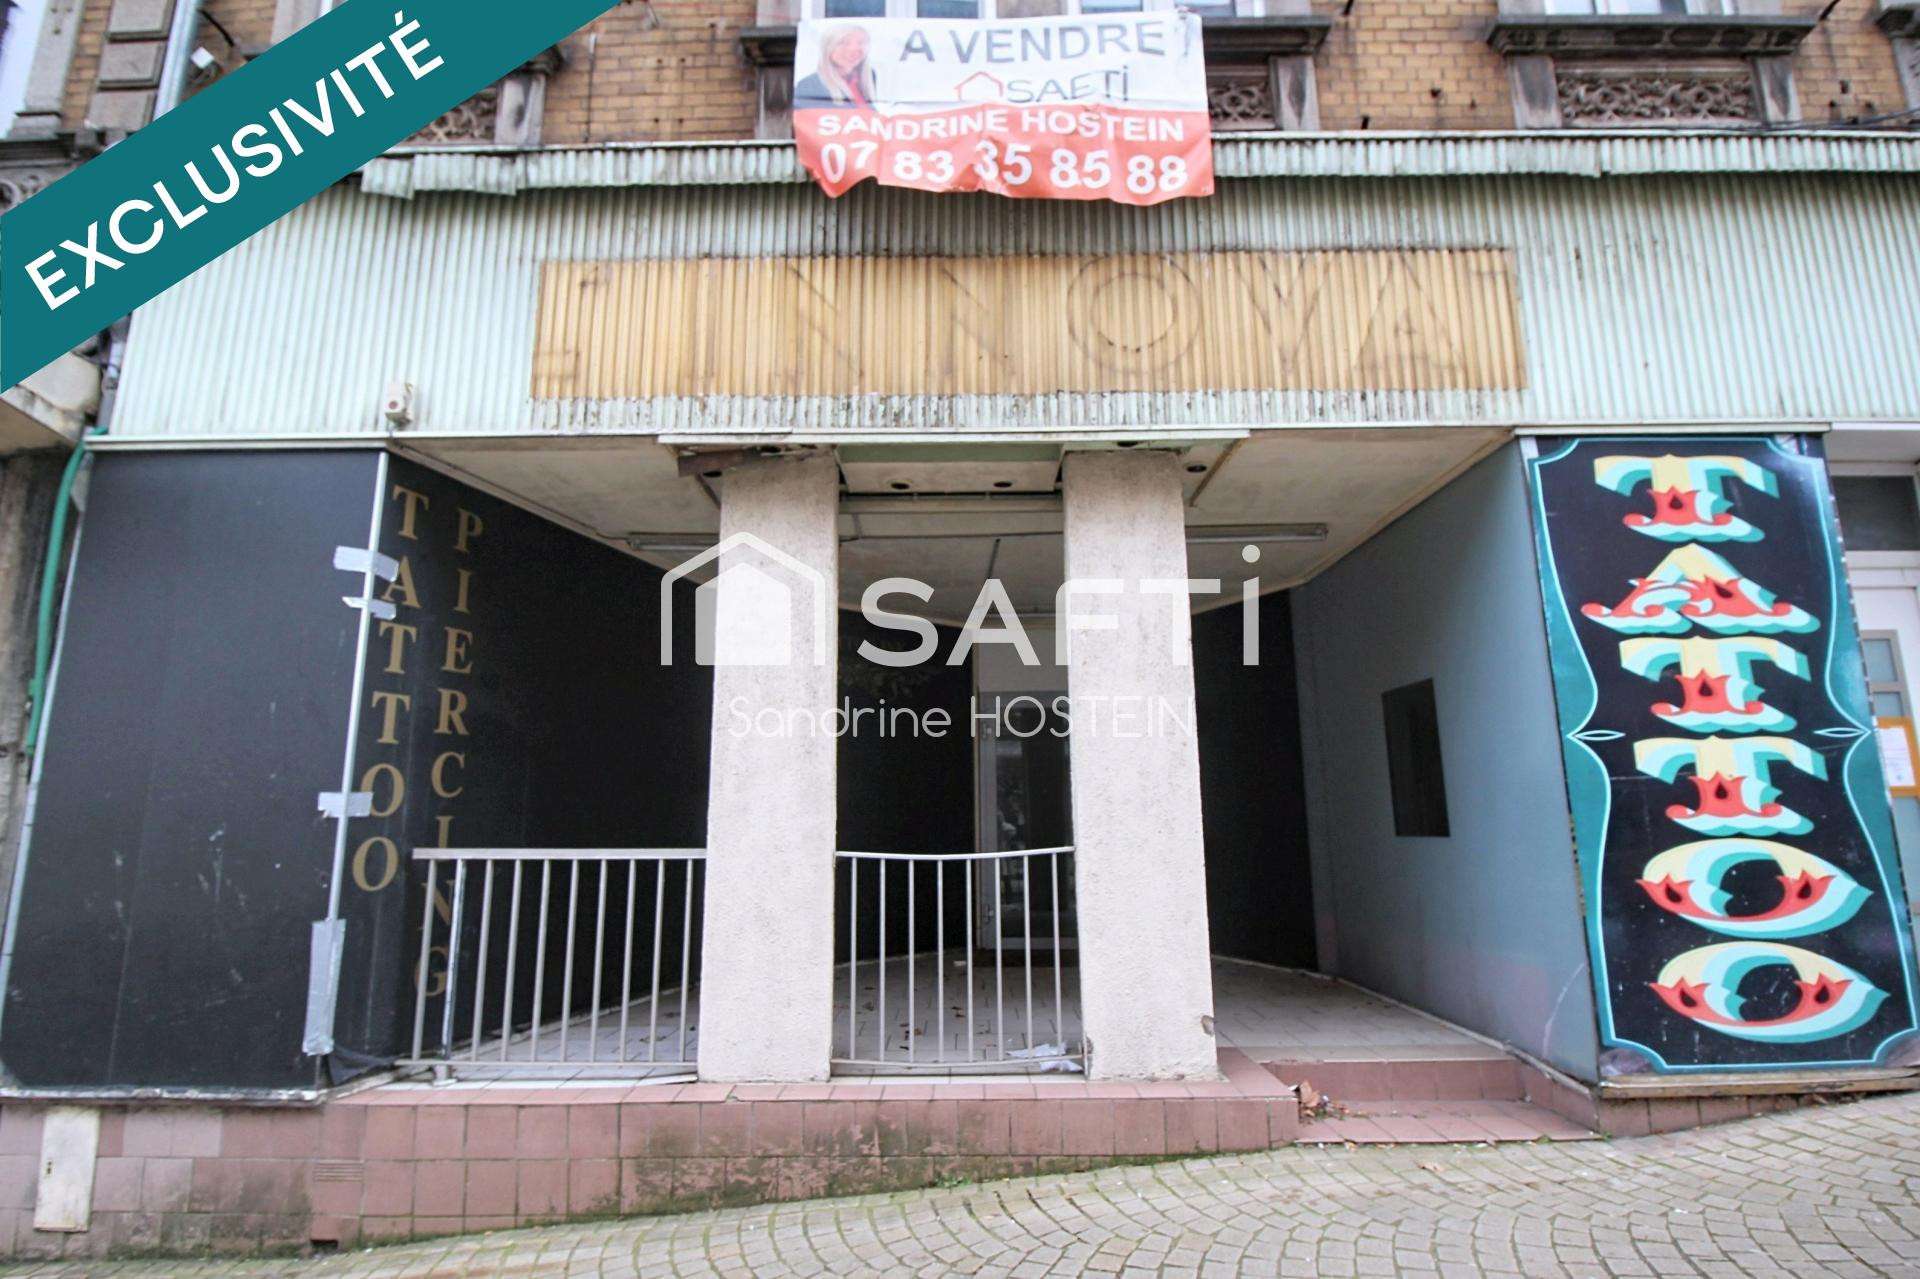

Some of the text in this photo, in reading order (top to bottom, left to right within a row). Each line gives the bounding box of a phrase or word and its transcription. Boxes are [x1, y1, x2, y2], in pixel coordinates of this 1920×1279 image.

[899, 21, 1166, 65] A VENDRE
[817, 108, 1184, 142] SANDRINE HOSTEIN
[820, 139, 1188, 195] 07 83 35 85 88
[351, 485, 430, 893] TATTOO
[1580, 454, 1892, 1045] TATTOO
